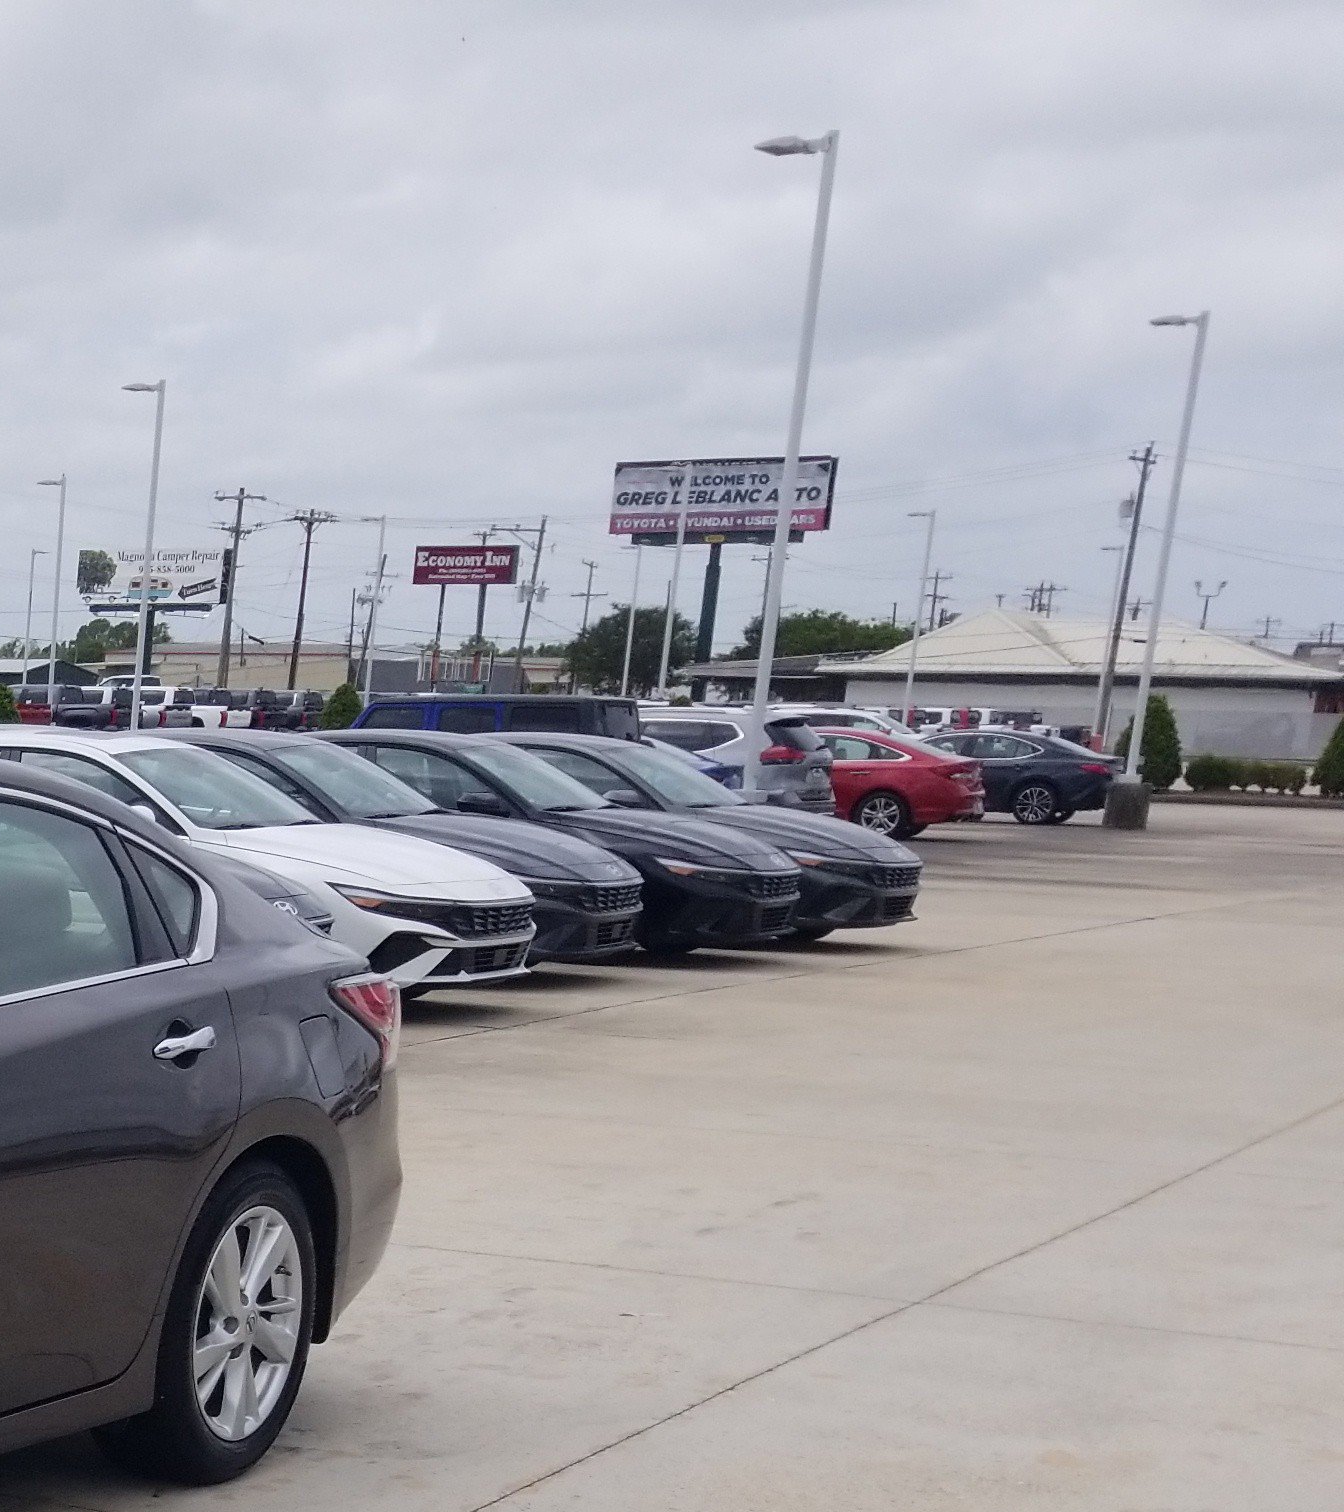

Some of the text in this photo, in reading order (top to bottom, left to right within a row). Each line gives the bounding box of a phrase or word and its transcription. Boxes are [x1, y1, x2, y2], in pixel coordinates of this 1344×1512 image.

[749, 473, 770, 486] TO
[616, 491, 668, 506] GREG
[765, 486, 822, 502] ATO
[615, 518, 666, 529] TOYOTA
[786, 513, 815, 526] ARS
[117, 551, 155, 564] Magnoa
[191, 550, 221, 564] Repair
